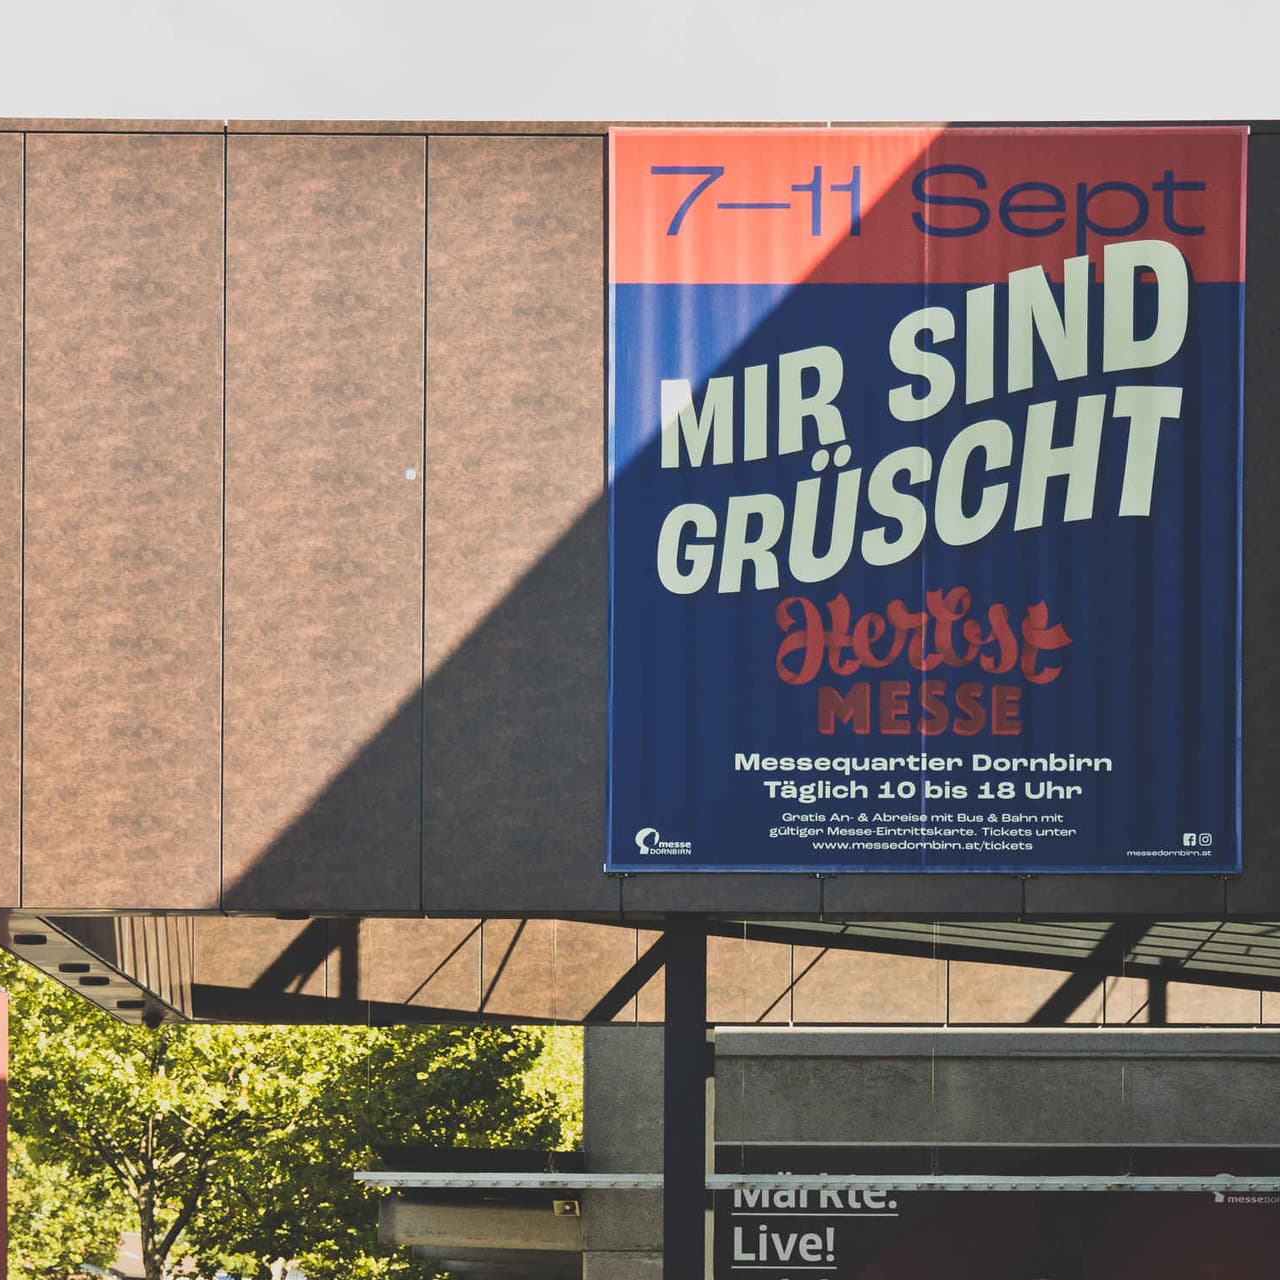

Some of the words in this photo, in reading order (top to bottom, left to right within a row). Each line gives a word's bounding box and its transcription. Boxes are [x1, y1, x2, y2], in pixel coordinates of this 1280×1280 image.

[911, 164, 1207, 257] Sept
[660, 344, 847, 470] MIR
[888, 239, 1189, 422] SIND
[656, 385, 1184, 595] GRÜSCHT
[775, 585, 1073, 686] Herbst
[818, 680, 1023, 736] MESSE
[734, 752, 964, 776] Messequartier
[972, 753, 1113, 772] Dornbirn
[763, 780, 869, 804] Täglich
[877, 781, 917, 799] 10
[924, 780, 969, 799] bis
[977, 781, 1016, 799] 18
[1024, 781, 1083, 799] Uhr
[782, 812, 826, 823] Gratis
[829, 812, 854, 823] An-
[857, 812, 869, 823] &
[871, 812, 928, 823] Abreise
[931, 812, 954, 823] mit
[957, 812, 984, 823] Bus
[987, 812, 999, 823] &
[1001, 812, 1038, 823] Bahn
[1041, 812, 1064, 823] mit
[769, 826, 824, 838] gültiger
[827, 826, 978, 837] Messe-Eintrittskarte.
[981, 826, 1033, 837] Tickets
[1035, 827, 1077, 837] unter
[649, 847, 692, 856] DORNBIRN
[658, 840, 692, 849] messe
[812, 840, 1033, 852] www.messedornbirn.at/tickets
[1126, 848, 1212, 857] messedornbirn.at
[733, 1224, 836, 1262] Live!
